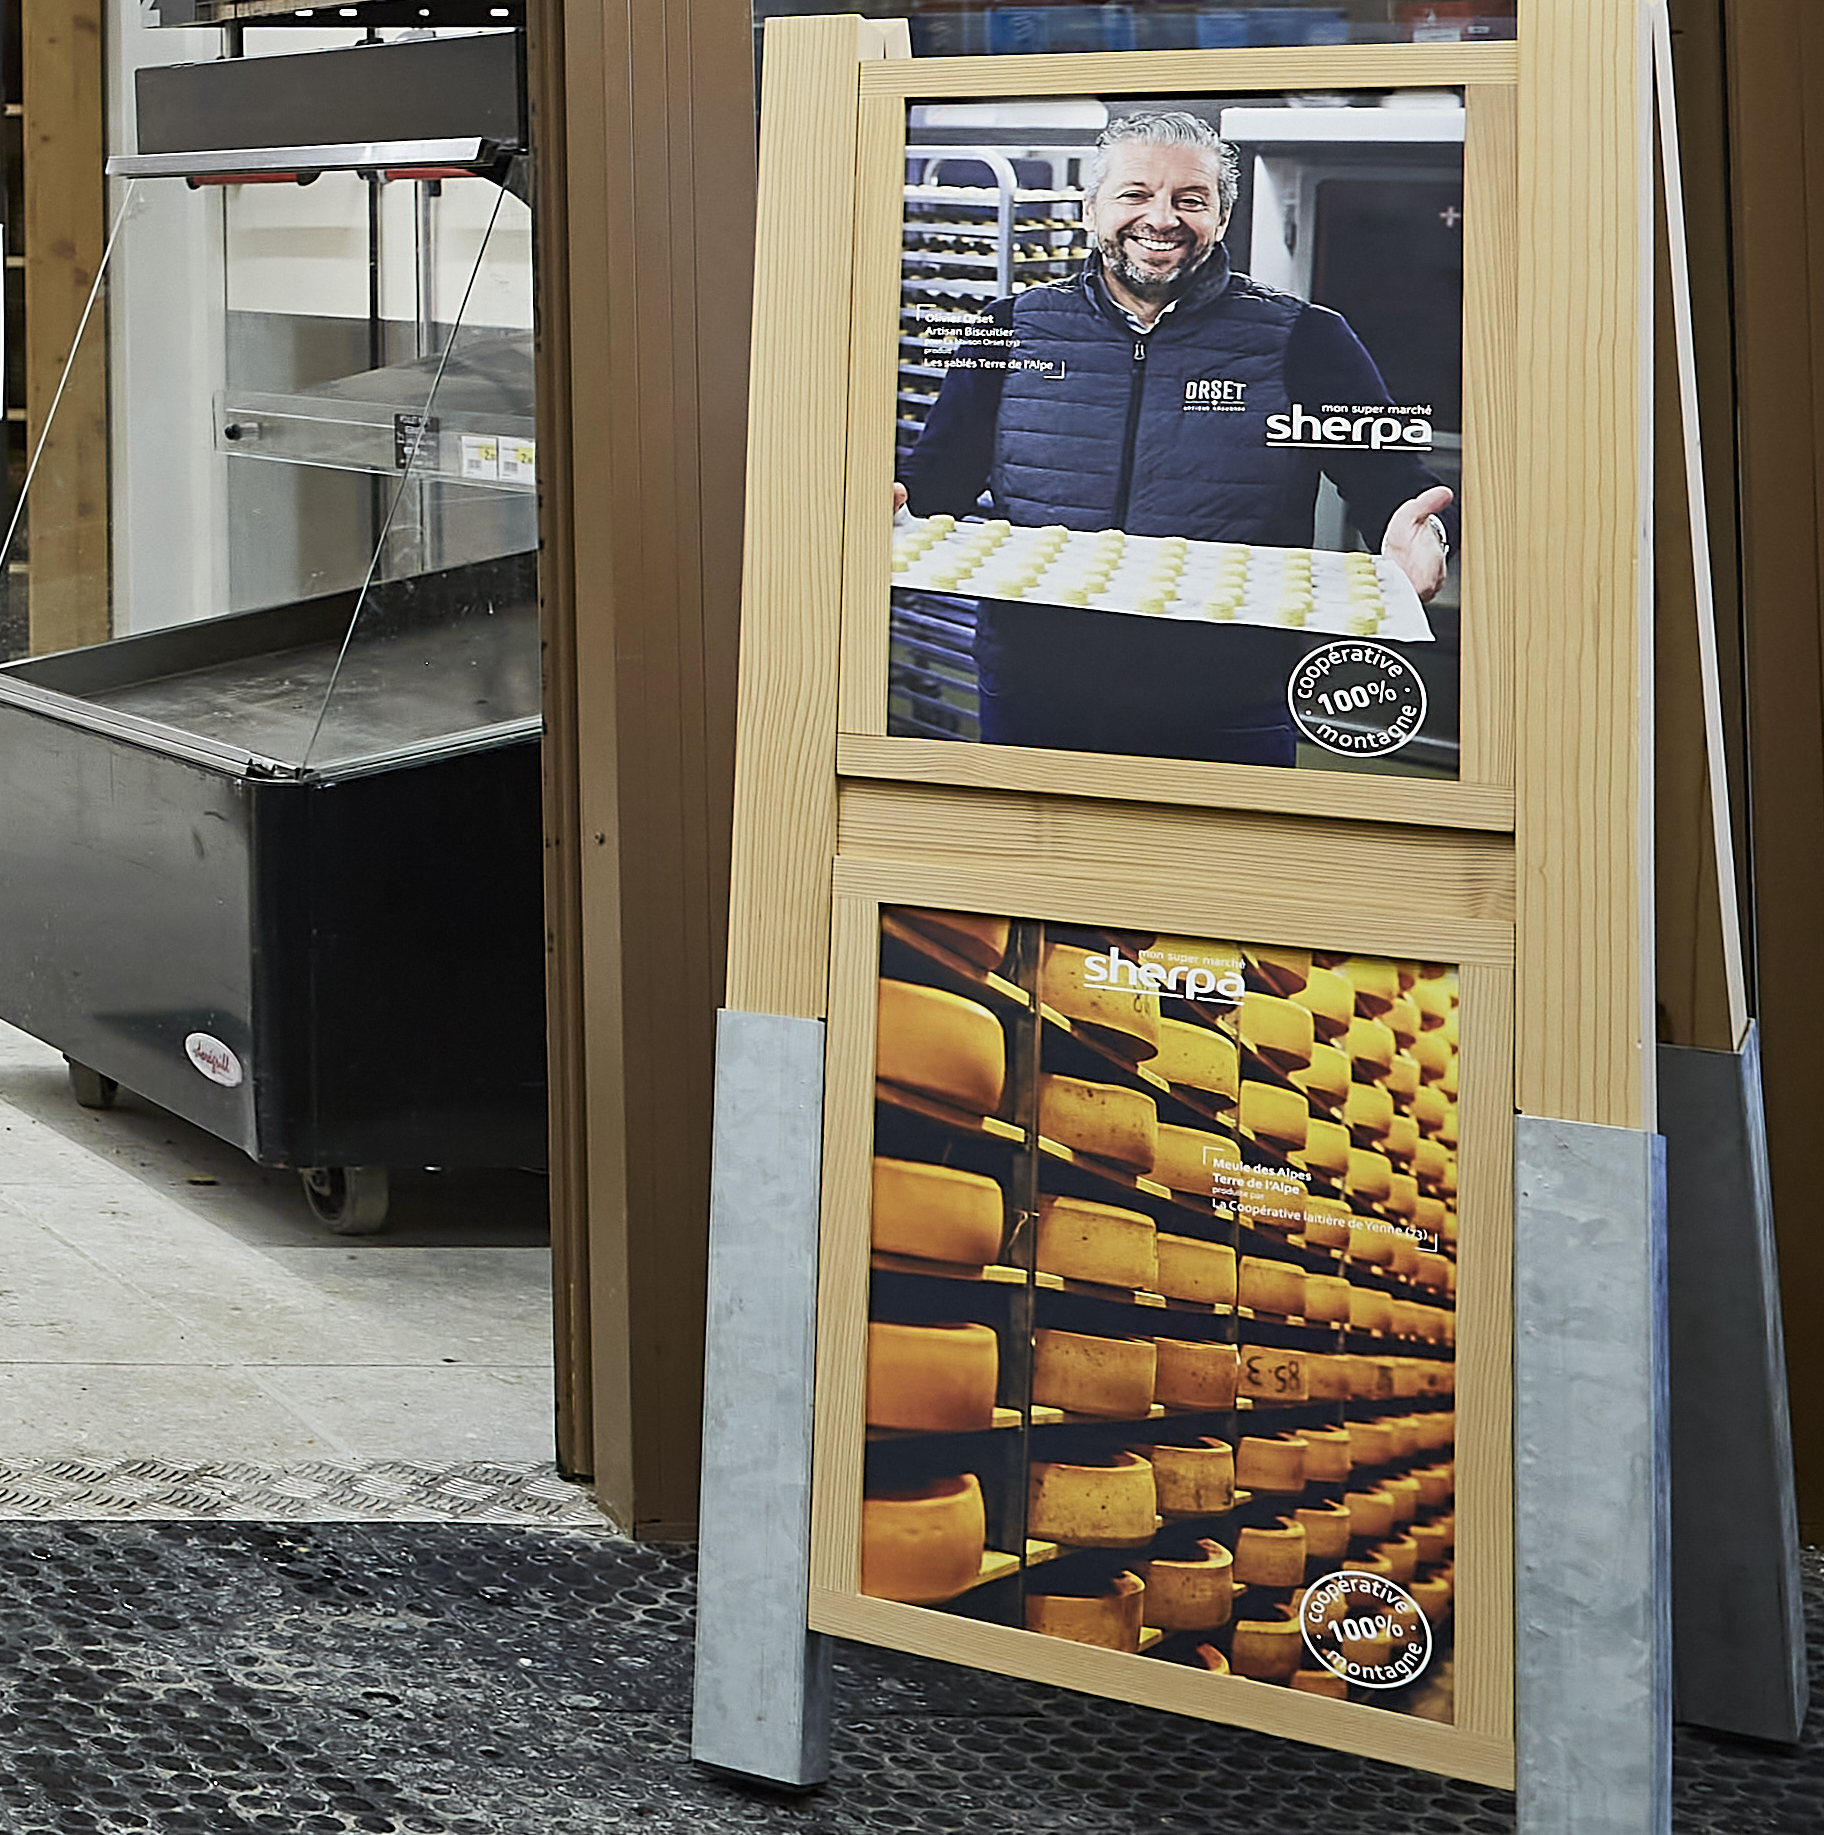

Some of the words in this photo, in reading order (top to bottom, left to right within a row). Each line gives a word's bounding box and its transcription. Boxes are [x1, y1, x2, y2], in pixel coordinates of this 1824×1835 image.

[924, 327, 963, 336] Artisan
[964, 327, 1015, 337] Biscuitier
[963, 314, 995, 324] Orset
[924, 358, 943, 367] Les
[944, 358, 978, 368] sablés
[979, 359, 1005, 369] Terre
[1007, 359, 1022, 369] de
[1185, 379, 1247, 401] ORSET
[1321, 404, 1349, 413] mon
[1351, 404, 1385, 415] super
[1387, 403, 1433, 415] marché
[1266, 403, 1433, 450] sherpa
[1297, 646, 1403, 699] coopérative
[1317, 679, 1397, 715] 100%
[1316, 704, 1418, 749] montagne
[1084, 946, 1246, 1000] sherpa
[1138, 949, 1164, 960] mon
[1167, 952, 1199, 965] super
[1202, 955, 1246, 969] marché
[1212, 1172, 1245, 1186] Terre
[1247, 1176, 1263, 1189] de
[1213, 1158, 1251, 1173] Meule
[1253, 1163, 1276, 1175] des
[1277, 1167, 1312, 1182] Alpes
[1212, 1198, 1227, 1210] La
[1229, 1200, 1301, 1221] Coopérative
[1303, 1211, 1346, 1228] laitière
[1348, 1217, 1363, 1229] de
[1364, 1221, 1403, 1236] Yenne
[1405, 1225, 1428, 1242] (73)
[1308, 1574, 1409, 1624] coopérative
[1328, 1614, 1404, 1643] 100%
[1326, 1642, 1423, 1682] montagne
